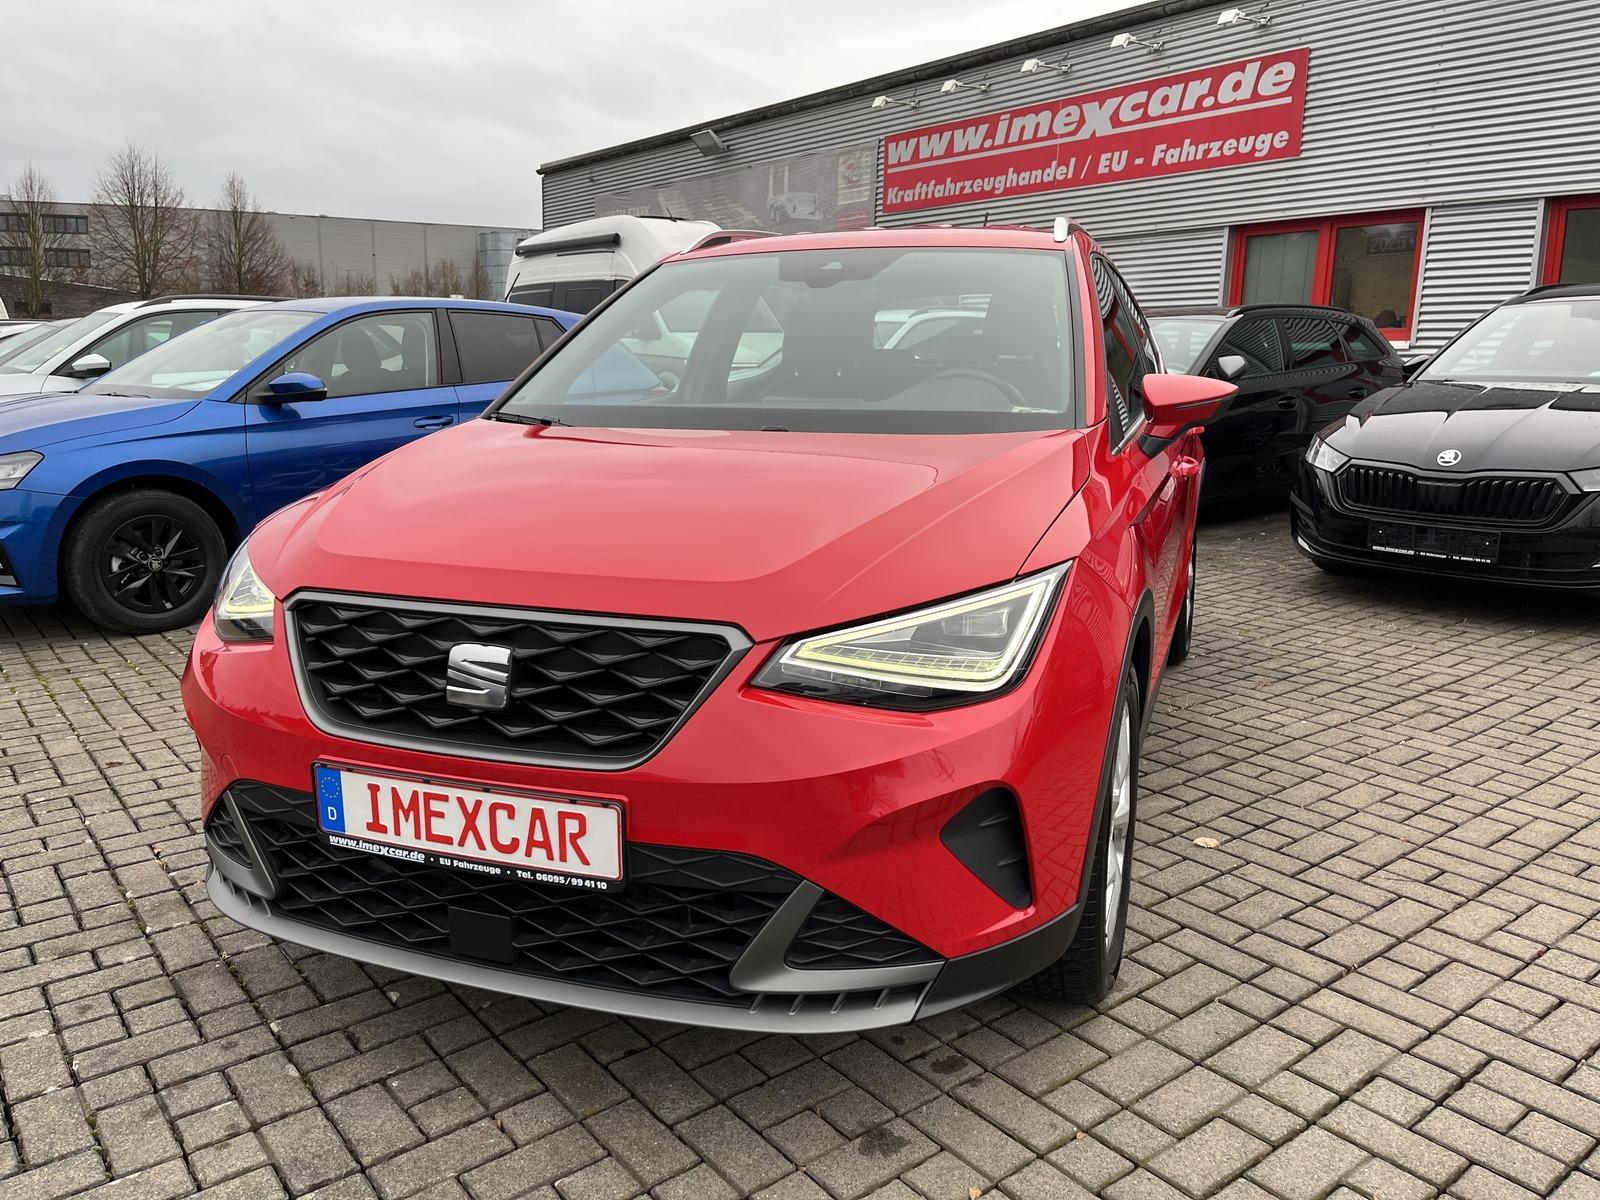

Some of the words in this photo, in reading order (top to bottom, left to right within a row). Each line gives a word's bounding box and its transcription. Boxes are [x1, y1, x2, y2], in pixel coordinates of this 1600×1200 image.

[887, 59, 1296, 165] www.imexcar.de
[886, 161, 1075, 205] Kraftfahrzeughandel
[1097, 150, 1128, 174] EU
[1152, 130, 1289, 167] Fahrzeuge
[327, 806, 337, 820] D
[366, 782, 591, 866] IMEXCAR
[329, 835, 425, 862] www.imexcar.de
[439, 857, 451, 866] EU
[453, 860, 501, 875] Fahrzeuge
[516, 870, 534, 880] Tel.
